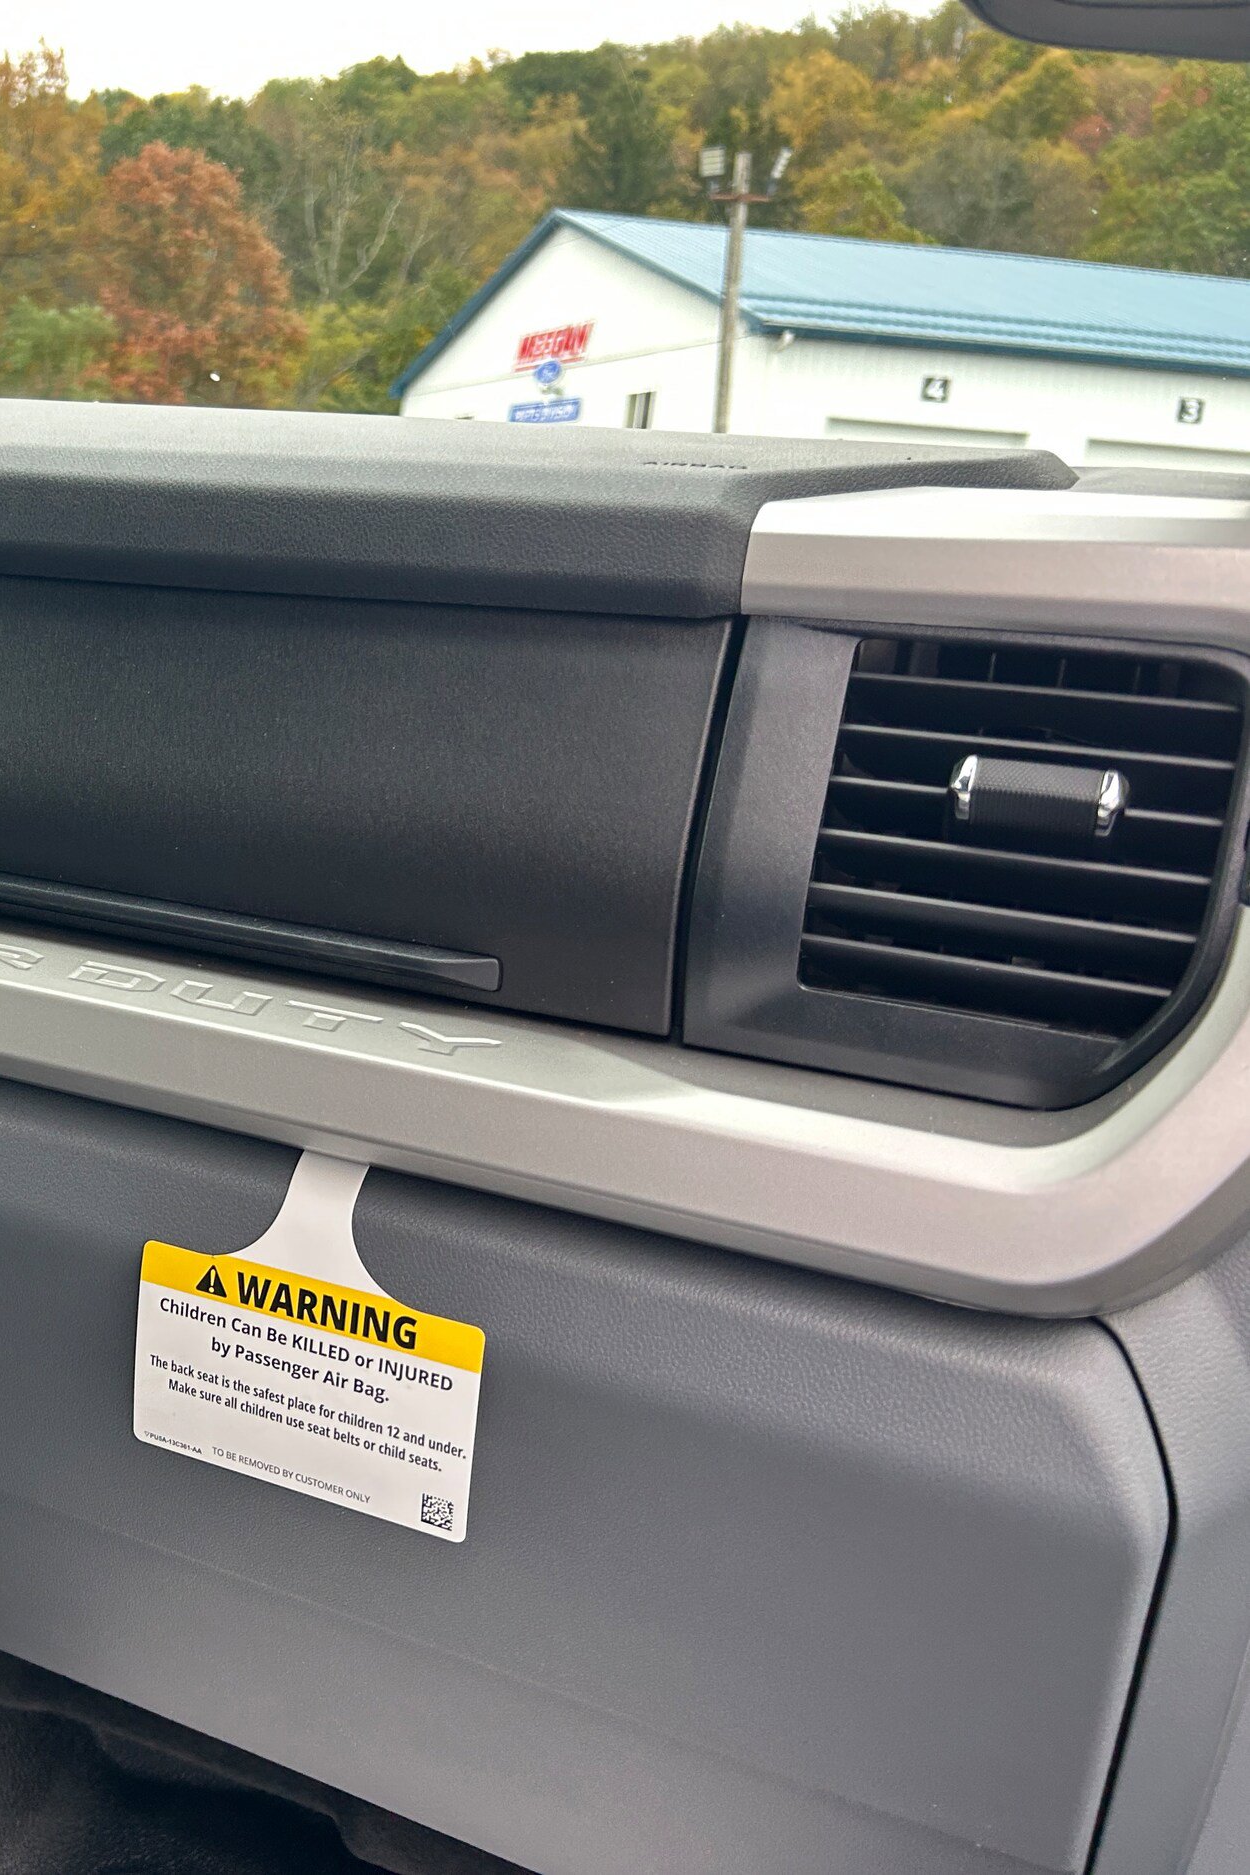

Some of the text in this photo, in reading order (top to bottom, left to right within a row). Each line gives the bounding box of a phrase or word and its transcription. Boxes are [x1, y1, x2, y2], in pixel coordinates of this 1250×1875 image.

[68, 960, 503, 1056] DUTY
[160, 1298, 453, 1390] Children Can Be KILLED or INJURED
[238, 1271, 417, 1350] WARNING
[150, 1354, 466, 1459] The back seat is the safest place for children 12 and under.
[212, 1337, 389, 1403] by Passenger Air Bag.
[169, 1379, 442, 1472] Make sure all children use seat belts or child seats.
[212, 1446, 371, 1504] TO BE REMOVED BY CUSTOMER ONLY
